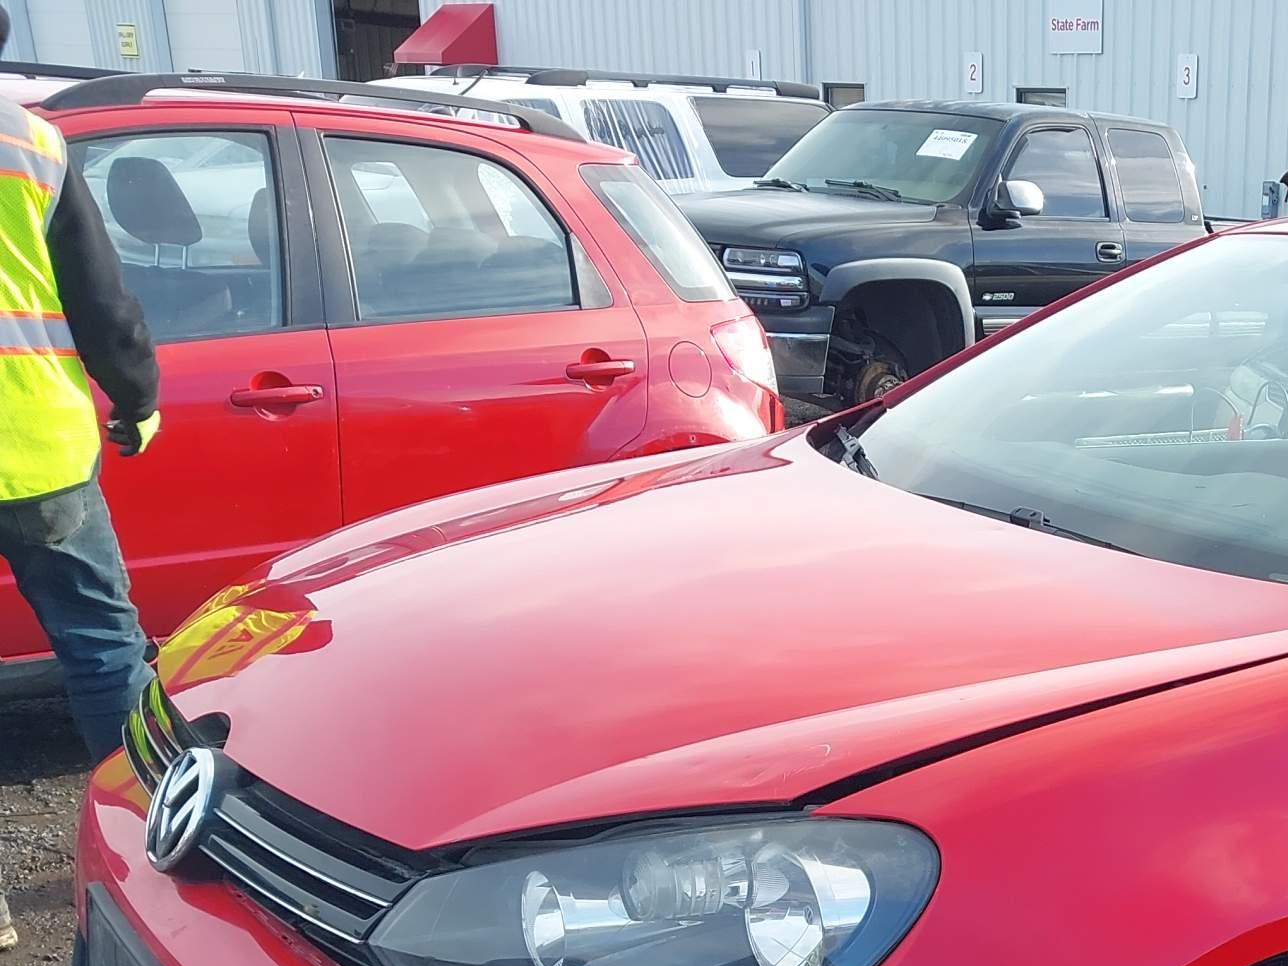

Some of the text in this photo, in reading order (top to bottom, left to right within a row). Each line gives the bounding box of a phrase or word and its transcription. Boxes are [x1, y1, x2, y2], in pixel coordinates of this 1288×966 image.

[1051, 18, 1099, 31] State Farm
[970, 63, 977, 81] 2
[1183, 66, 1190, 85] 3
[992, 292, 1015, 301] 2500
